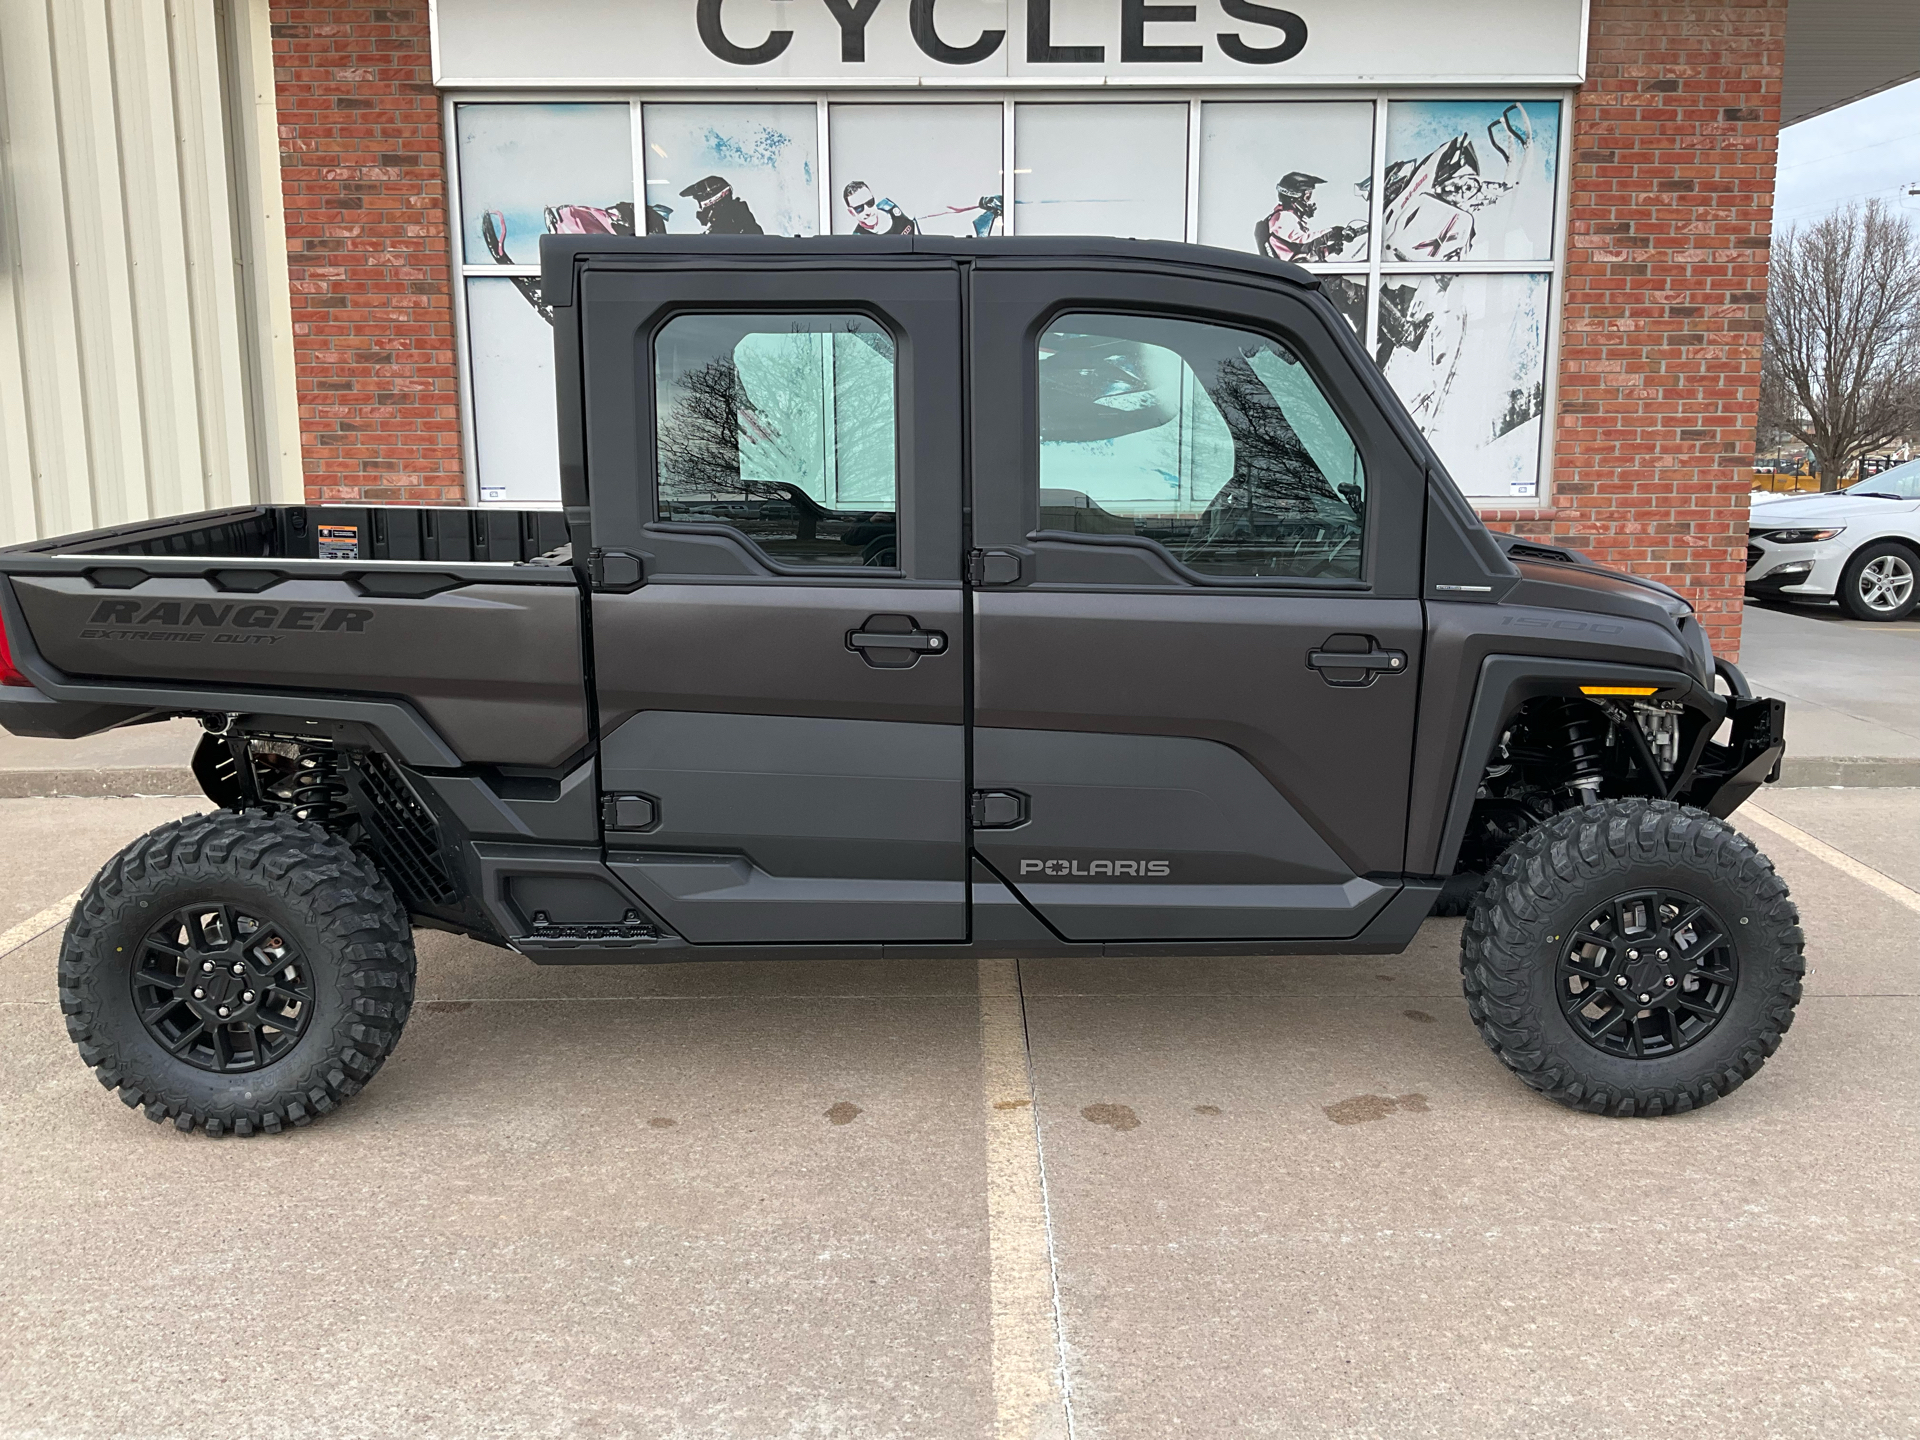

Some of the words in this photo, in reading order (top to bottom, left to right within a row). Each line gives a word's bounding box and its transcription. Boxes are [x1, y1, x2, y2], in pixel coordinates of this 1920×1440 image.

[696, 0, 1309, 65] CYCLES
[88, 599, 374, 632] RANGER
[1500, 615, 1625, 635] 1500
[78, 629, 206, 644] EXTREME
[212, 632, 286, 645] DUTY
[1019, 859, 1171, 876] POLARIS
